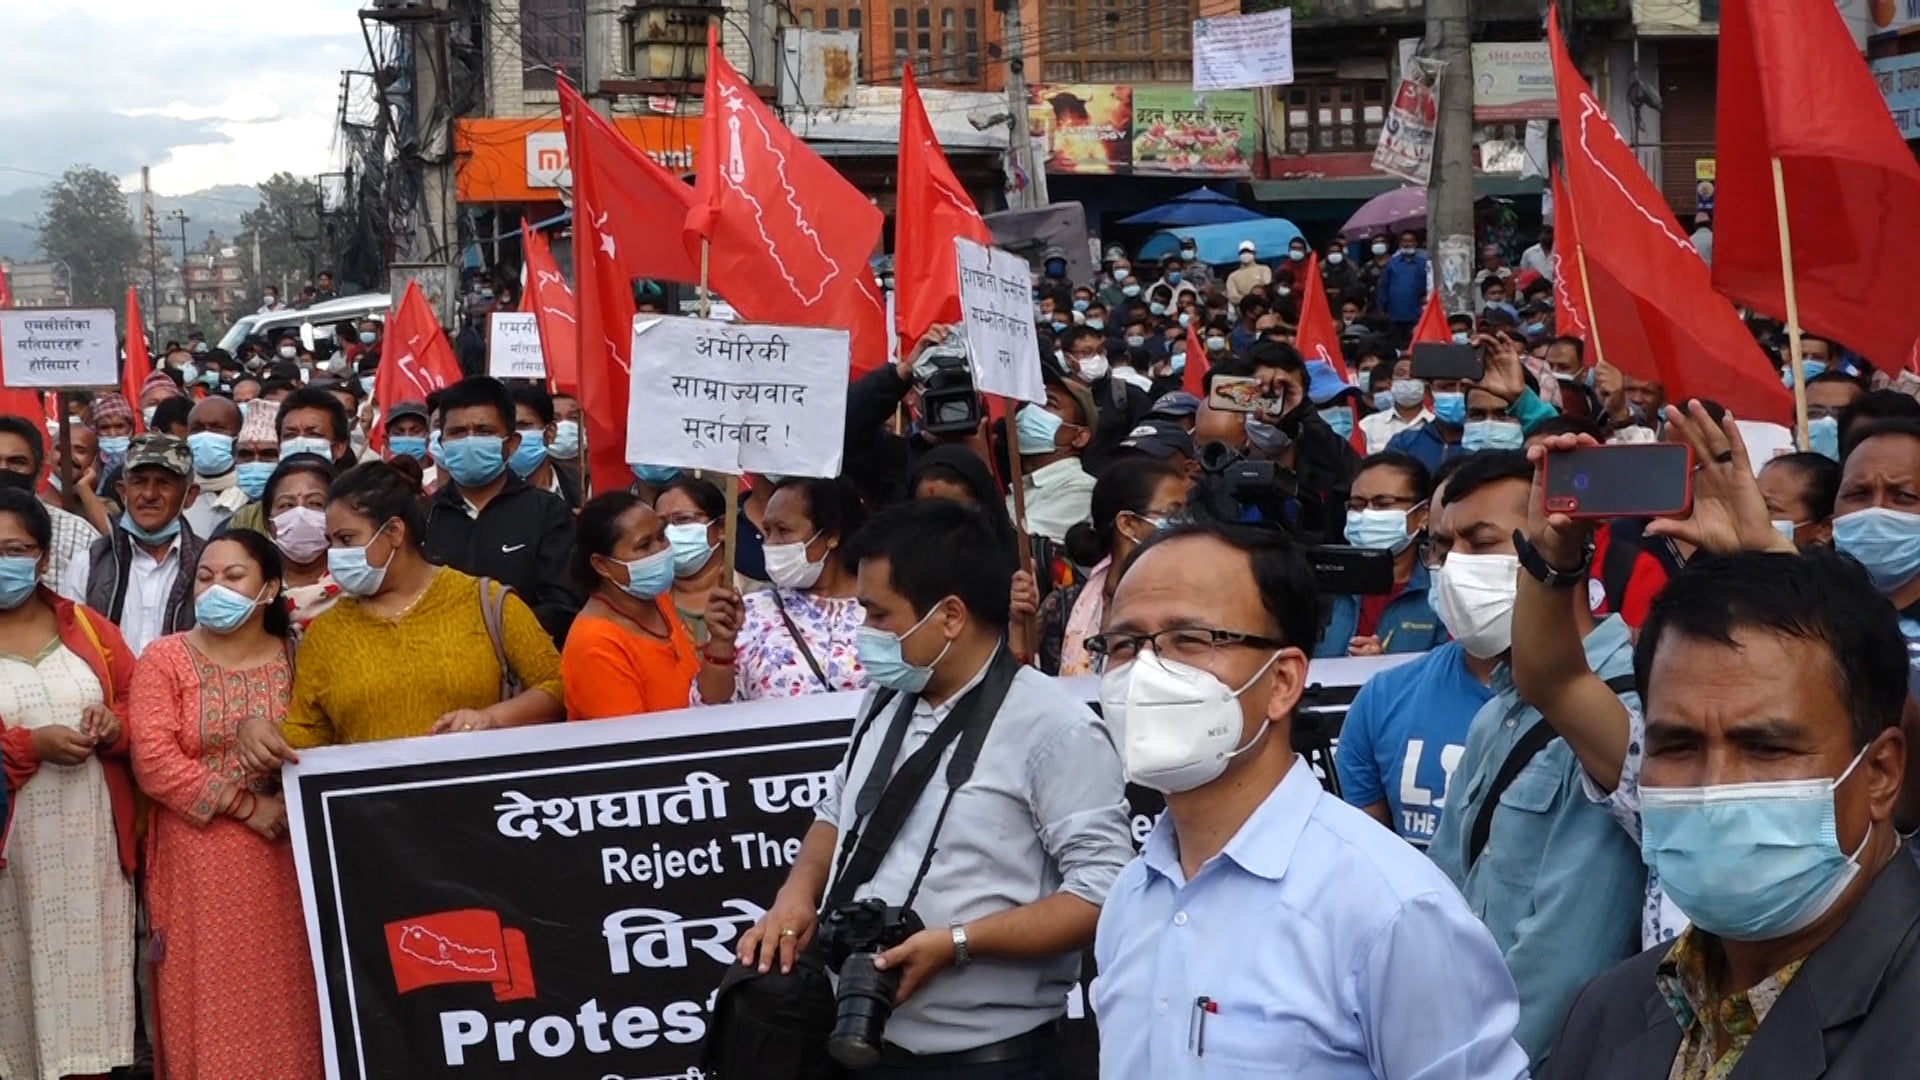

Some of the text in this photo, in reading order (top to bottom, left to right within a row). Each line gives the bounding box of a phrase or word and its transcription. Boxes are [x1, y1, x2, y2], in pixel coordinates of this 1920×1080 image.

[1488, 50, 1550, 61] SHEMROC
[499, 316, 537, 337] एमसी
[671, 376, 808, 406] साम्राज्यवाद
[494, 770, 837, 841] देशघाती एम
[1402, 811, 1437, 835] THE
[601, 831, 802, 889] Reject The
[439, 988, 720, 1066] Protes
